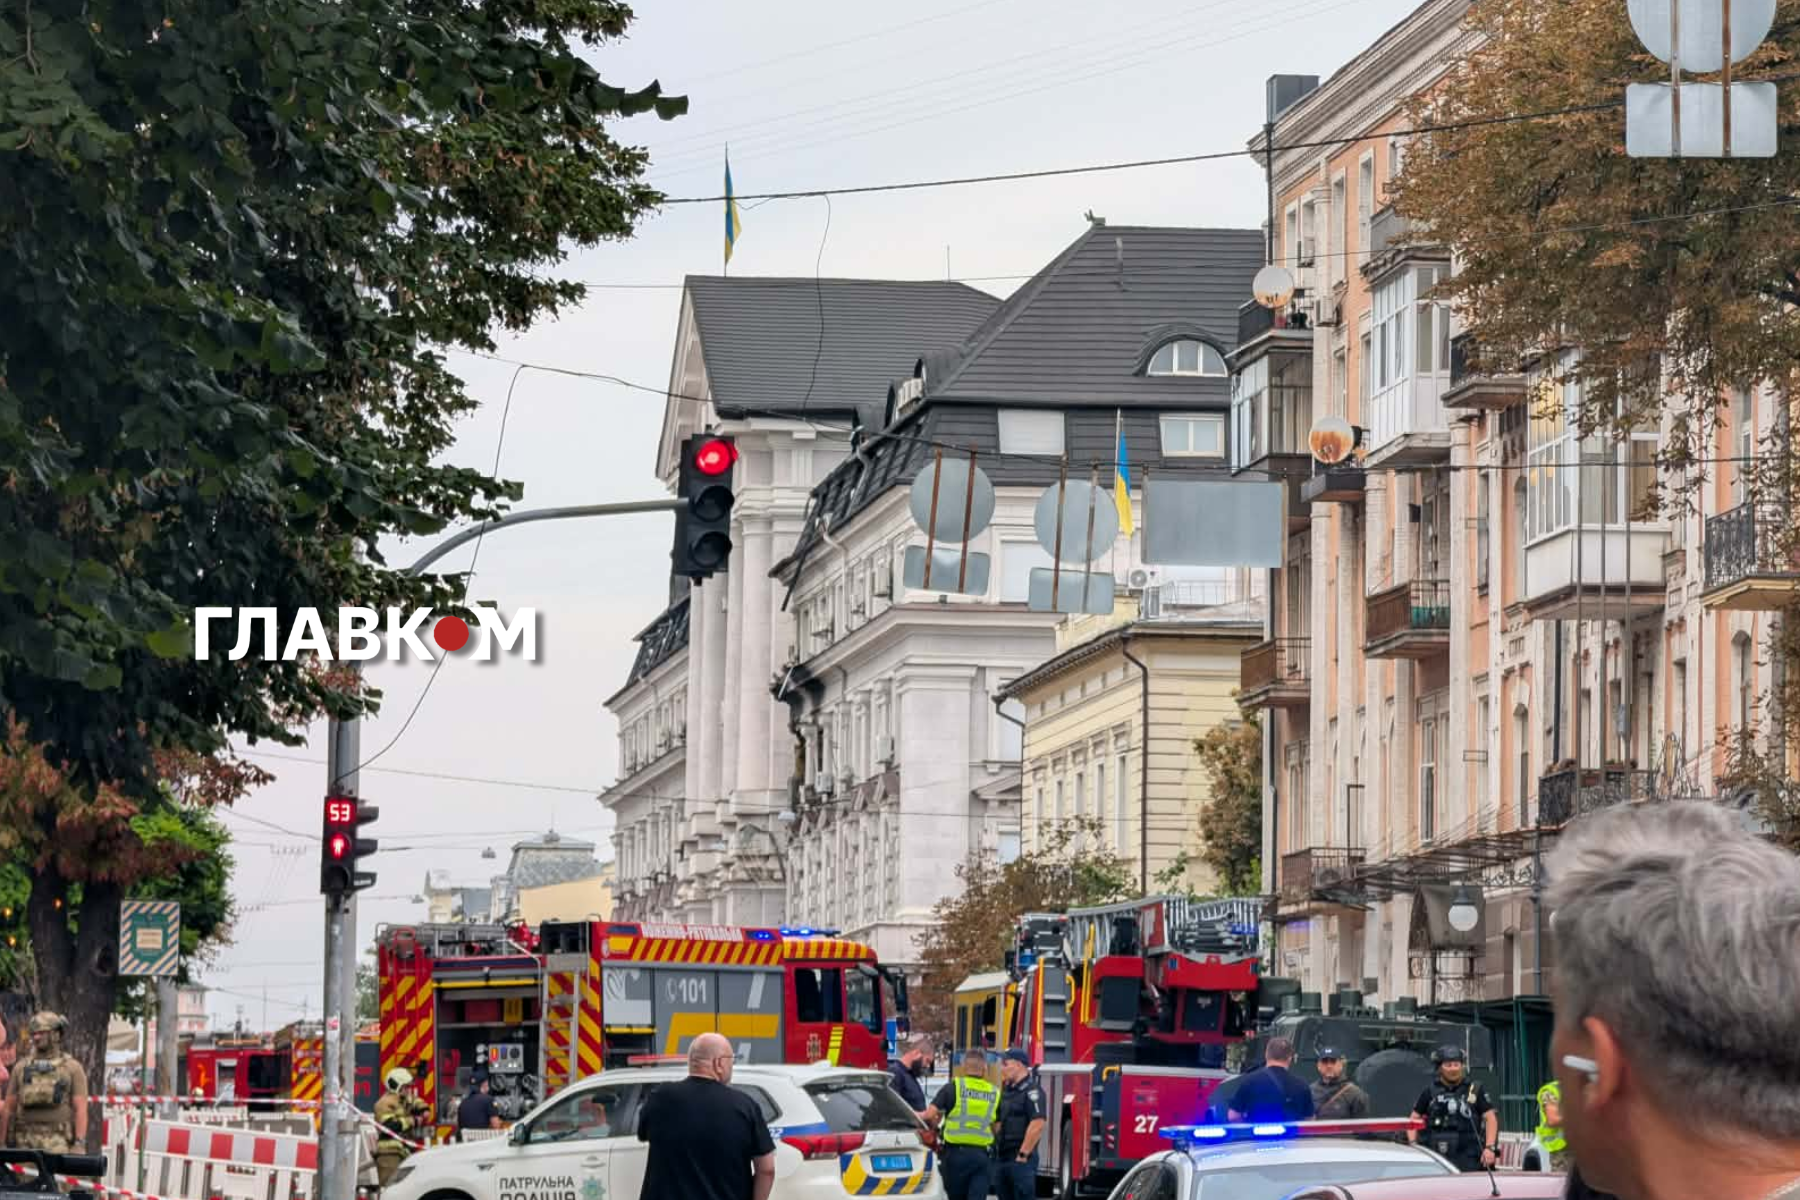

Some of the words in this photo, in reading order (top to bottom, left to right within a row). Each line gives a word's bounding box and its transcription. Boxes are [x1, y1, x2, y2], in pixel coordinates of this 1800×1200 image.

[329, 803, 351, 822] 53
[679, 978, 707, 1004] 101
[1133, 1114, 1160, 1134] 27
[499, 1176, 575, 1190] ПАТРУЛЬНА
